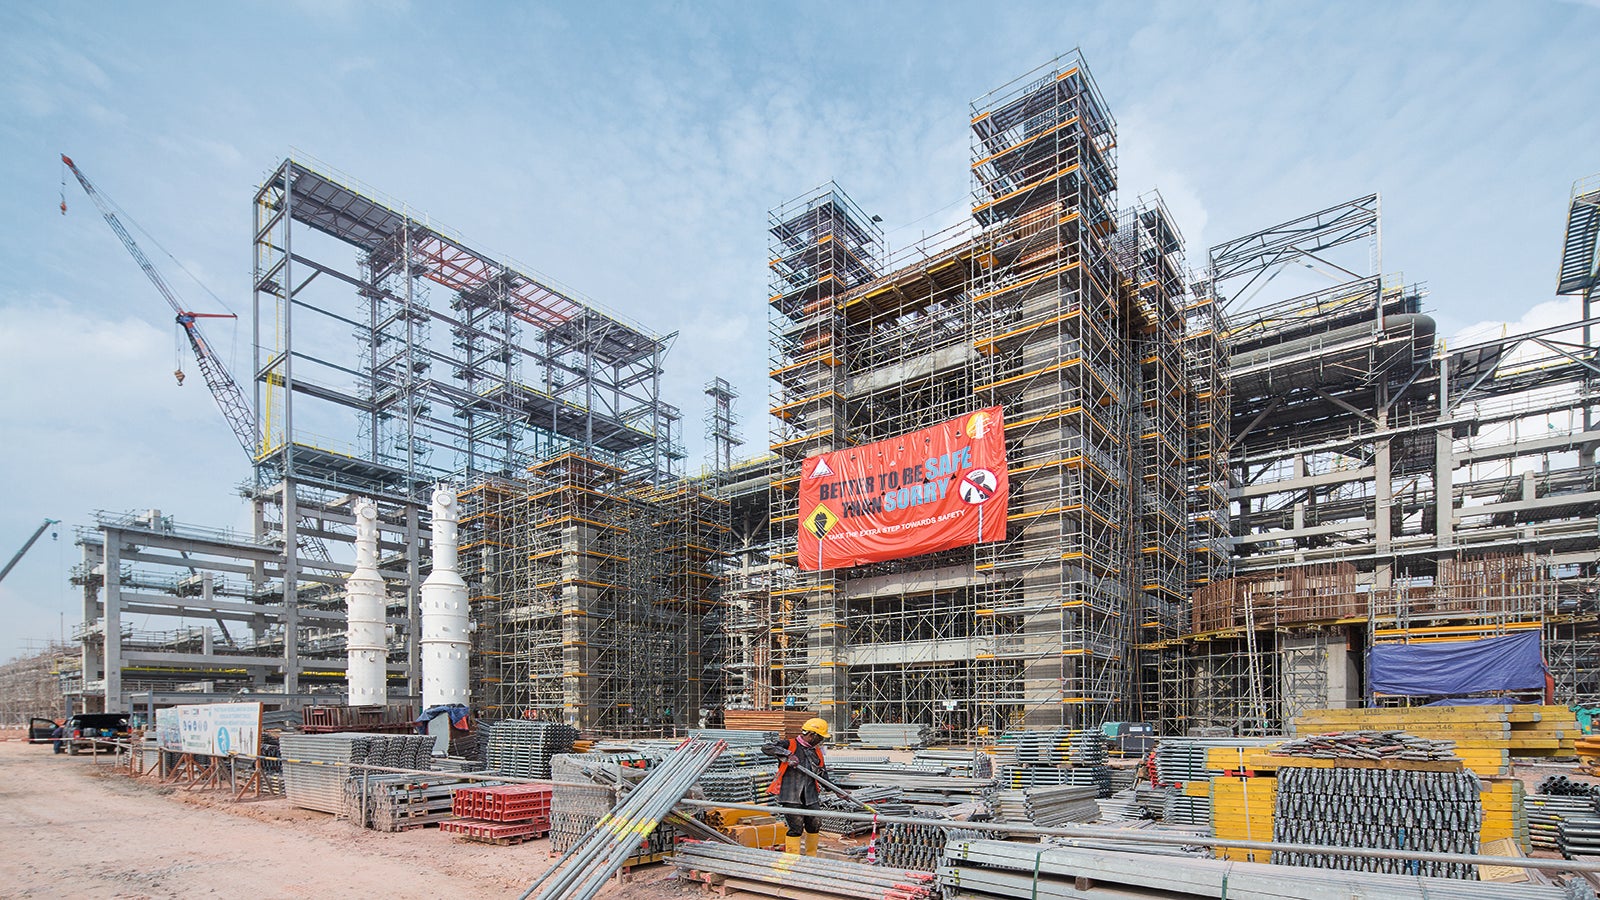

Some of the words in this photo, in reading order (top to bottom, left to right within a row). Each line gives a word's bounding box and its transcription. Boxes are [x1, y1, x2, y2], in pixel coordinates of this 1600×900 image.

[820, 474, 874, 500] BETTER
[878, 471, 898, 490] TO
[903, 465, 923, 485] BE
[925, 446, 972, 480] SAFE
[842, 496, 882, 518] THAN
[884, 478, 949, 512] SORRY
[828, 533, 844, 541] TAKE
[859, 528, 881, 537] EXTRA
[882, 525, 900, 534] STEP
[901, 517, 936, 530] TOWARDS
[937, 509, 965, 522] SAFETY
